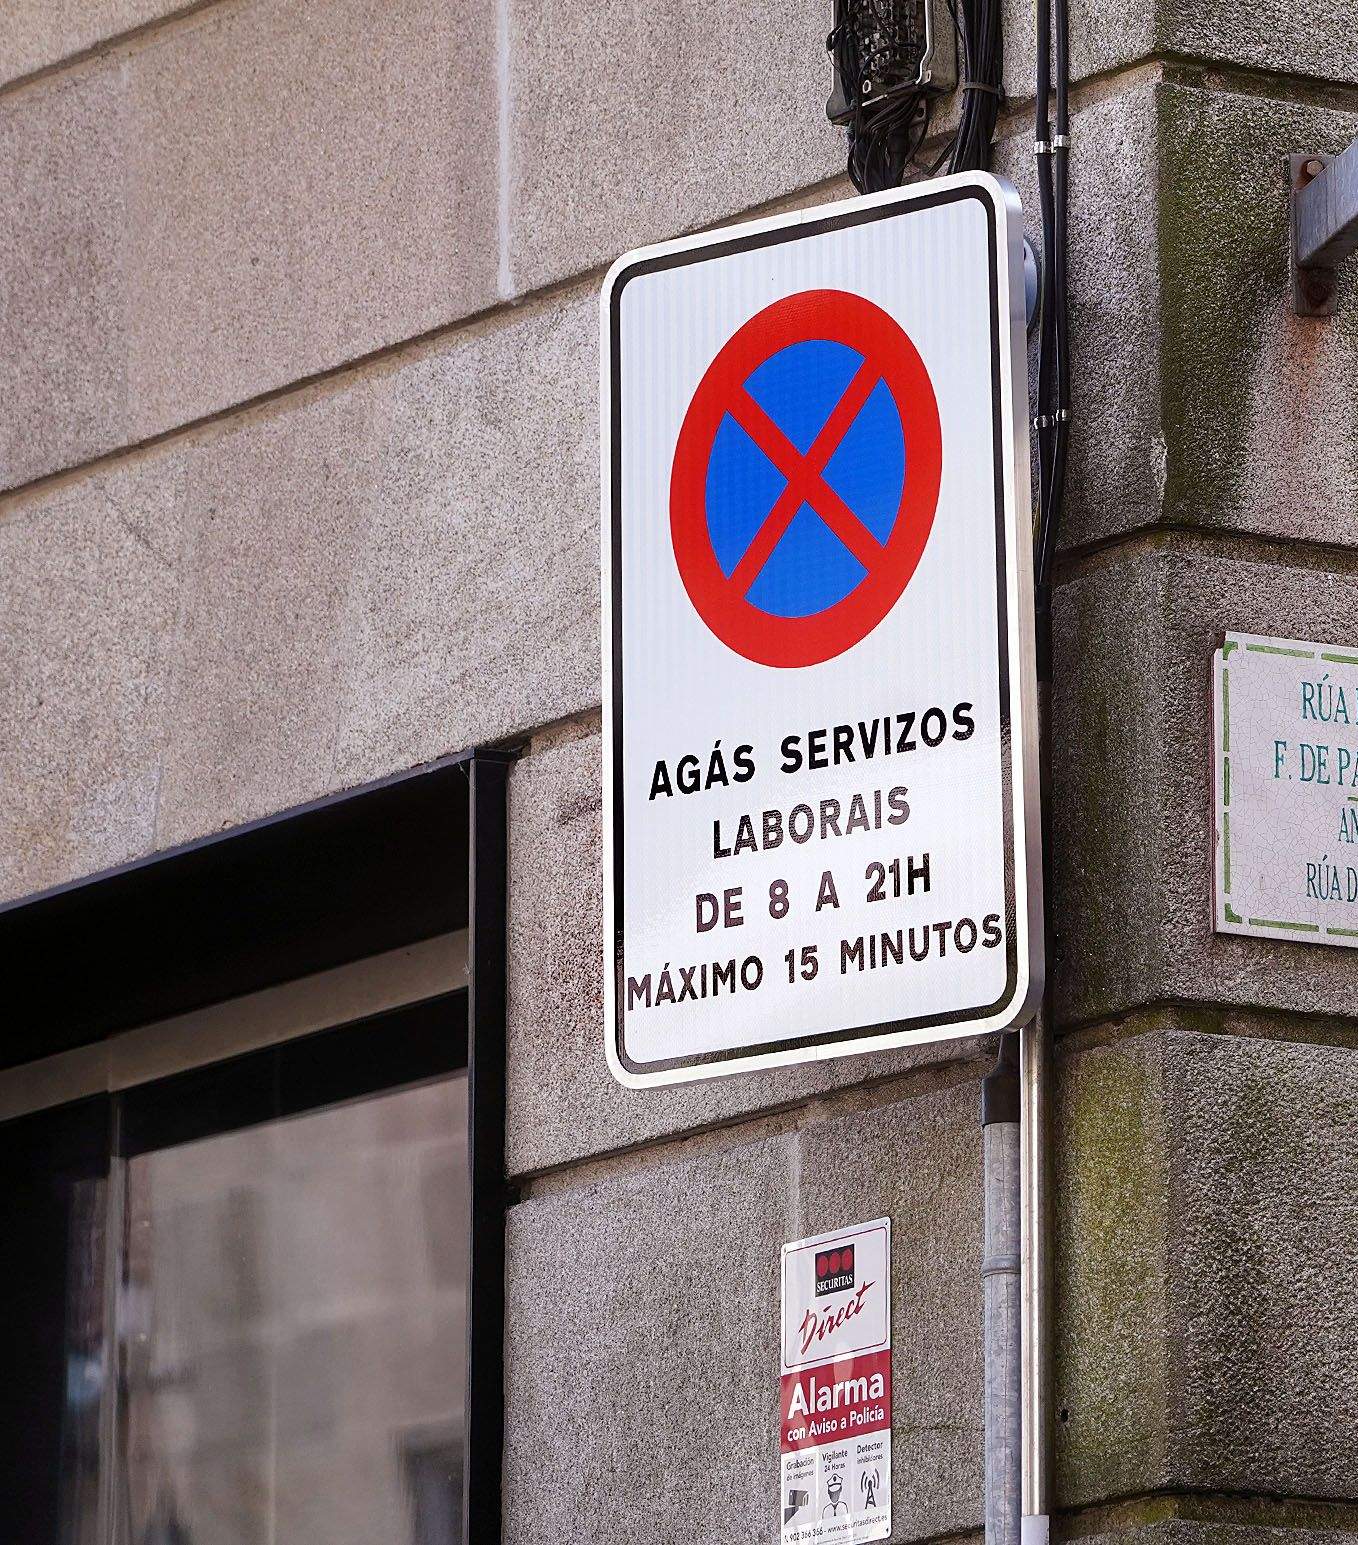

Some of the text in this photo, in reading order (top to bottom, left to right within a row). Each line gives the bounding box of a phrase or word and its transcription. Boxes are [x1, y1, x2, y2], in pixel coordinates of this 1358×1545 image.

[1301, 674, 1350, 724] RÚA
[648, 702, 976, 801] AGÁS SERVIZOS
[1274, 740, 1293, 780] F.
[1300, 743, 1331, 785] DE
[713, 786, 911, 859] LABORAIS
[695, 853, 931, 933] DE 8 A 21H
[1306, 854, 1343, 901] RÚA
[627, 913, 1003, 1011] MÁXIMO 15 MINUTOS
[816, 1274, 853, 1293] SECURITAS
[799, 1281, 876, 1355] Direct
[787, 1372, 884, 1420] Alarma
[787, 1405, 885, 1442] con Aviso a Policía
[822, 1449, 848, 1463] Vigilante
[856, 1442, 883, 1454] Detector
